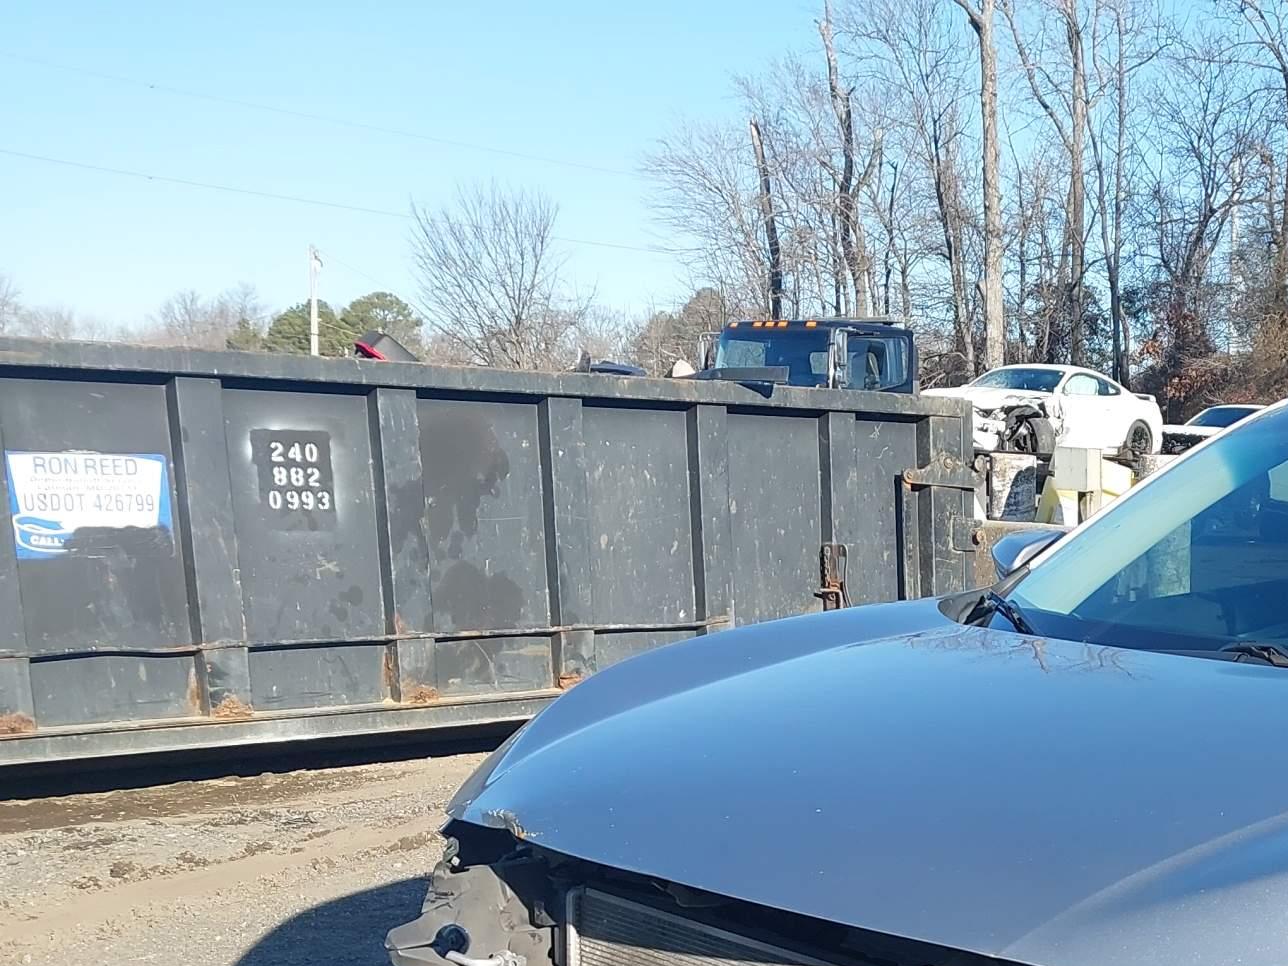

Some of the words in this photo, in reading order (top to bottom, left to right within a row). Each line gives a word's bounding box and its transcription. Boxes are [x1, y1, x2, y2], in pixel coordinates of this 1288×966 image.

[270, 442, 318, 462] 240
[33, 456, 78, 475] RON
[85, 458, 138, 476] REED
[273, 466, 320, 487] 882
[24, 493, 84, 512] USDOT
[94, 494, 155, 512] 426799
[269, 490, 330, 510] 0993
